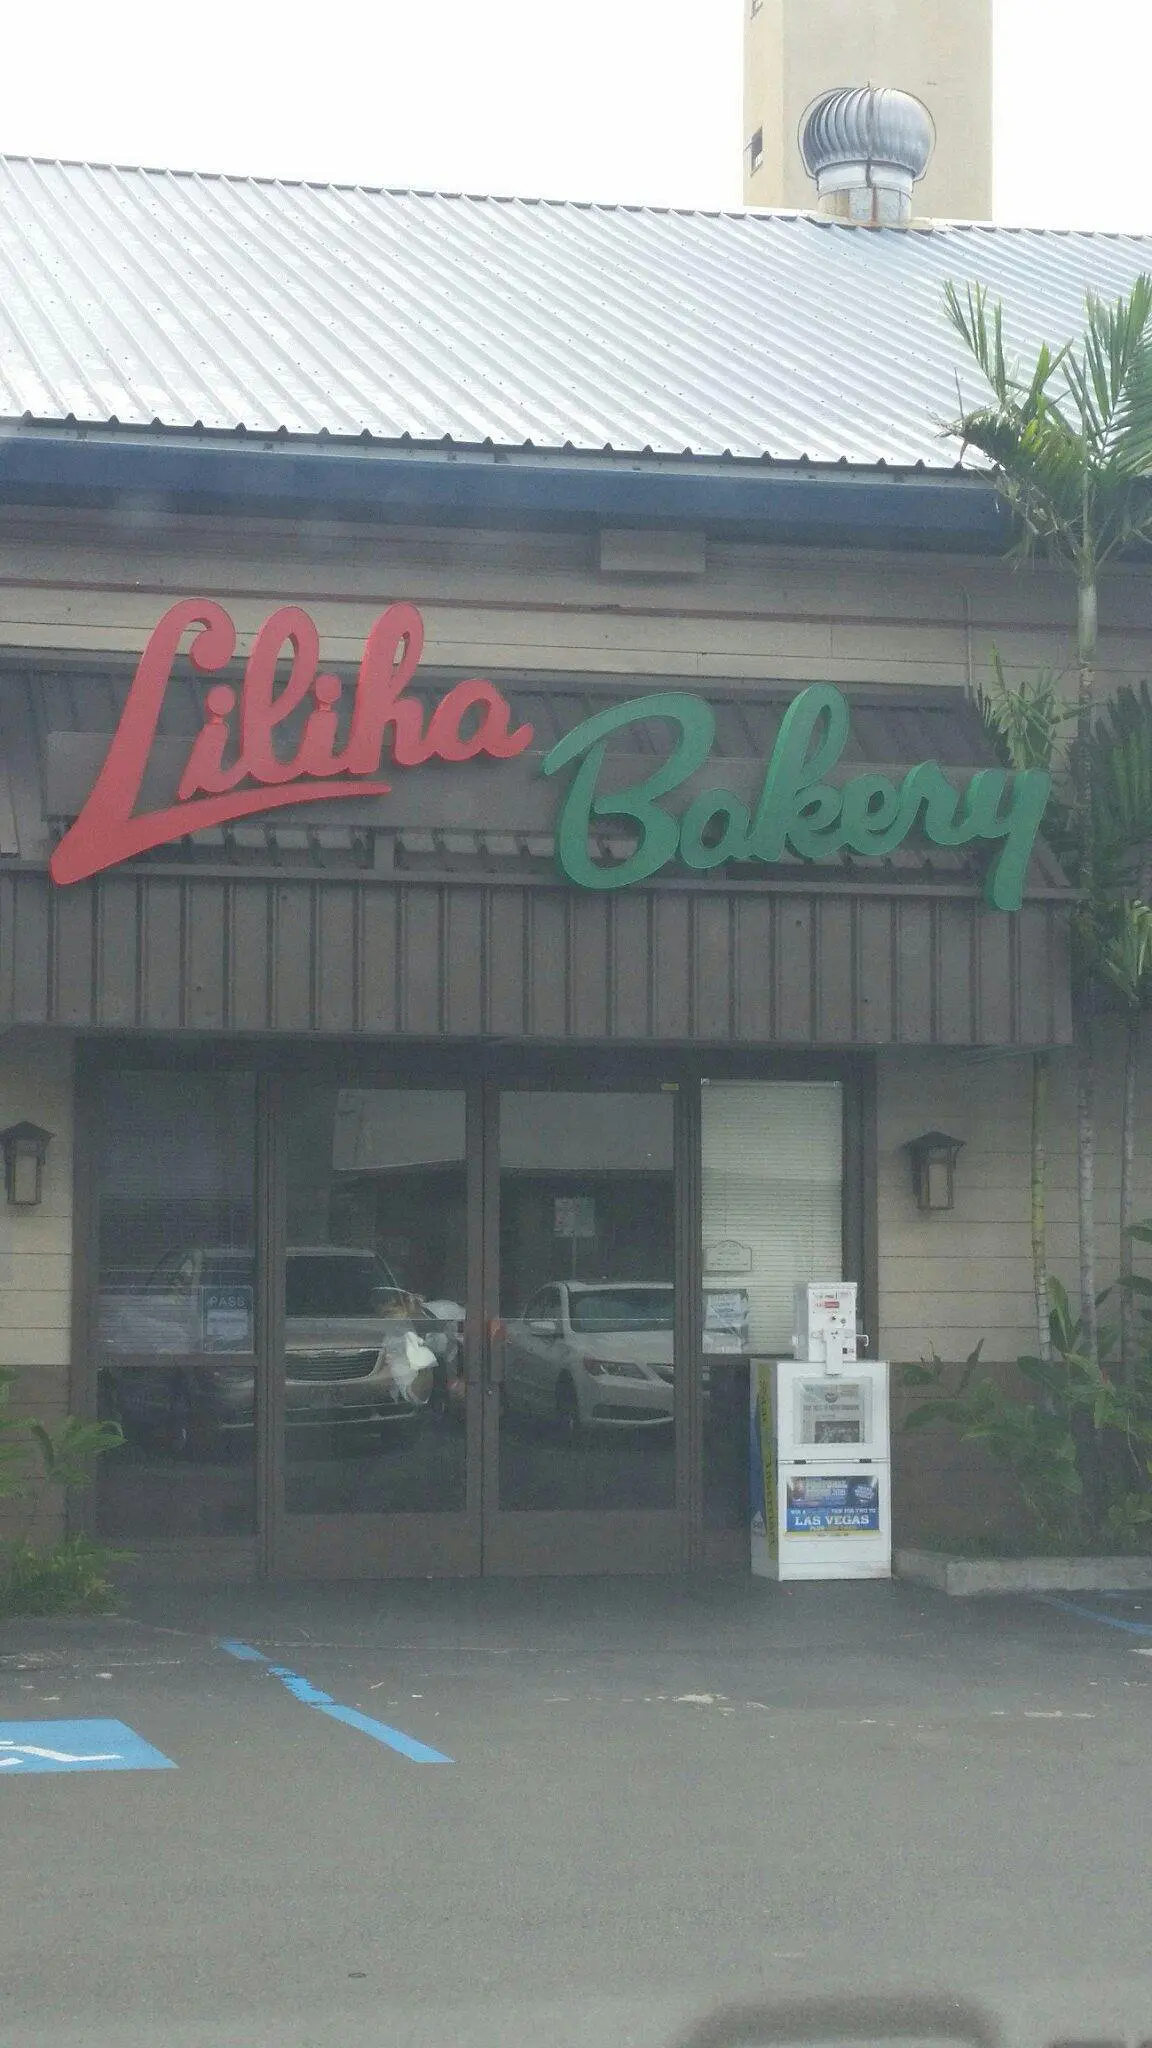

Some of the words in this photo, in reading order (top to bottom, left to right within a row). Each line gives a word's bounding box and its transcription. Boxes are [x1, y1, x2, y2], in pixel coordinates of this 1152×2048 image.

[50, 597, 533, 885] Liliha
[543, 682, 1051, 911] Bakery
[795, 1516, 820, 1525] LAS
[825, 1515, 869, 1524] VEGAS
